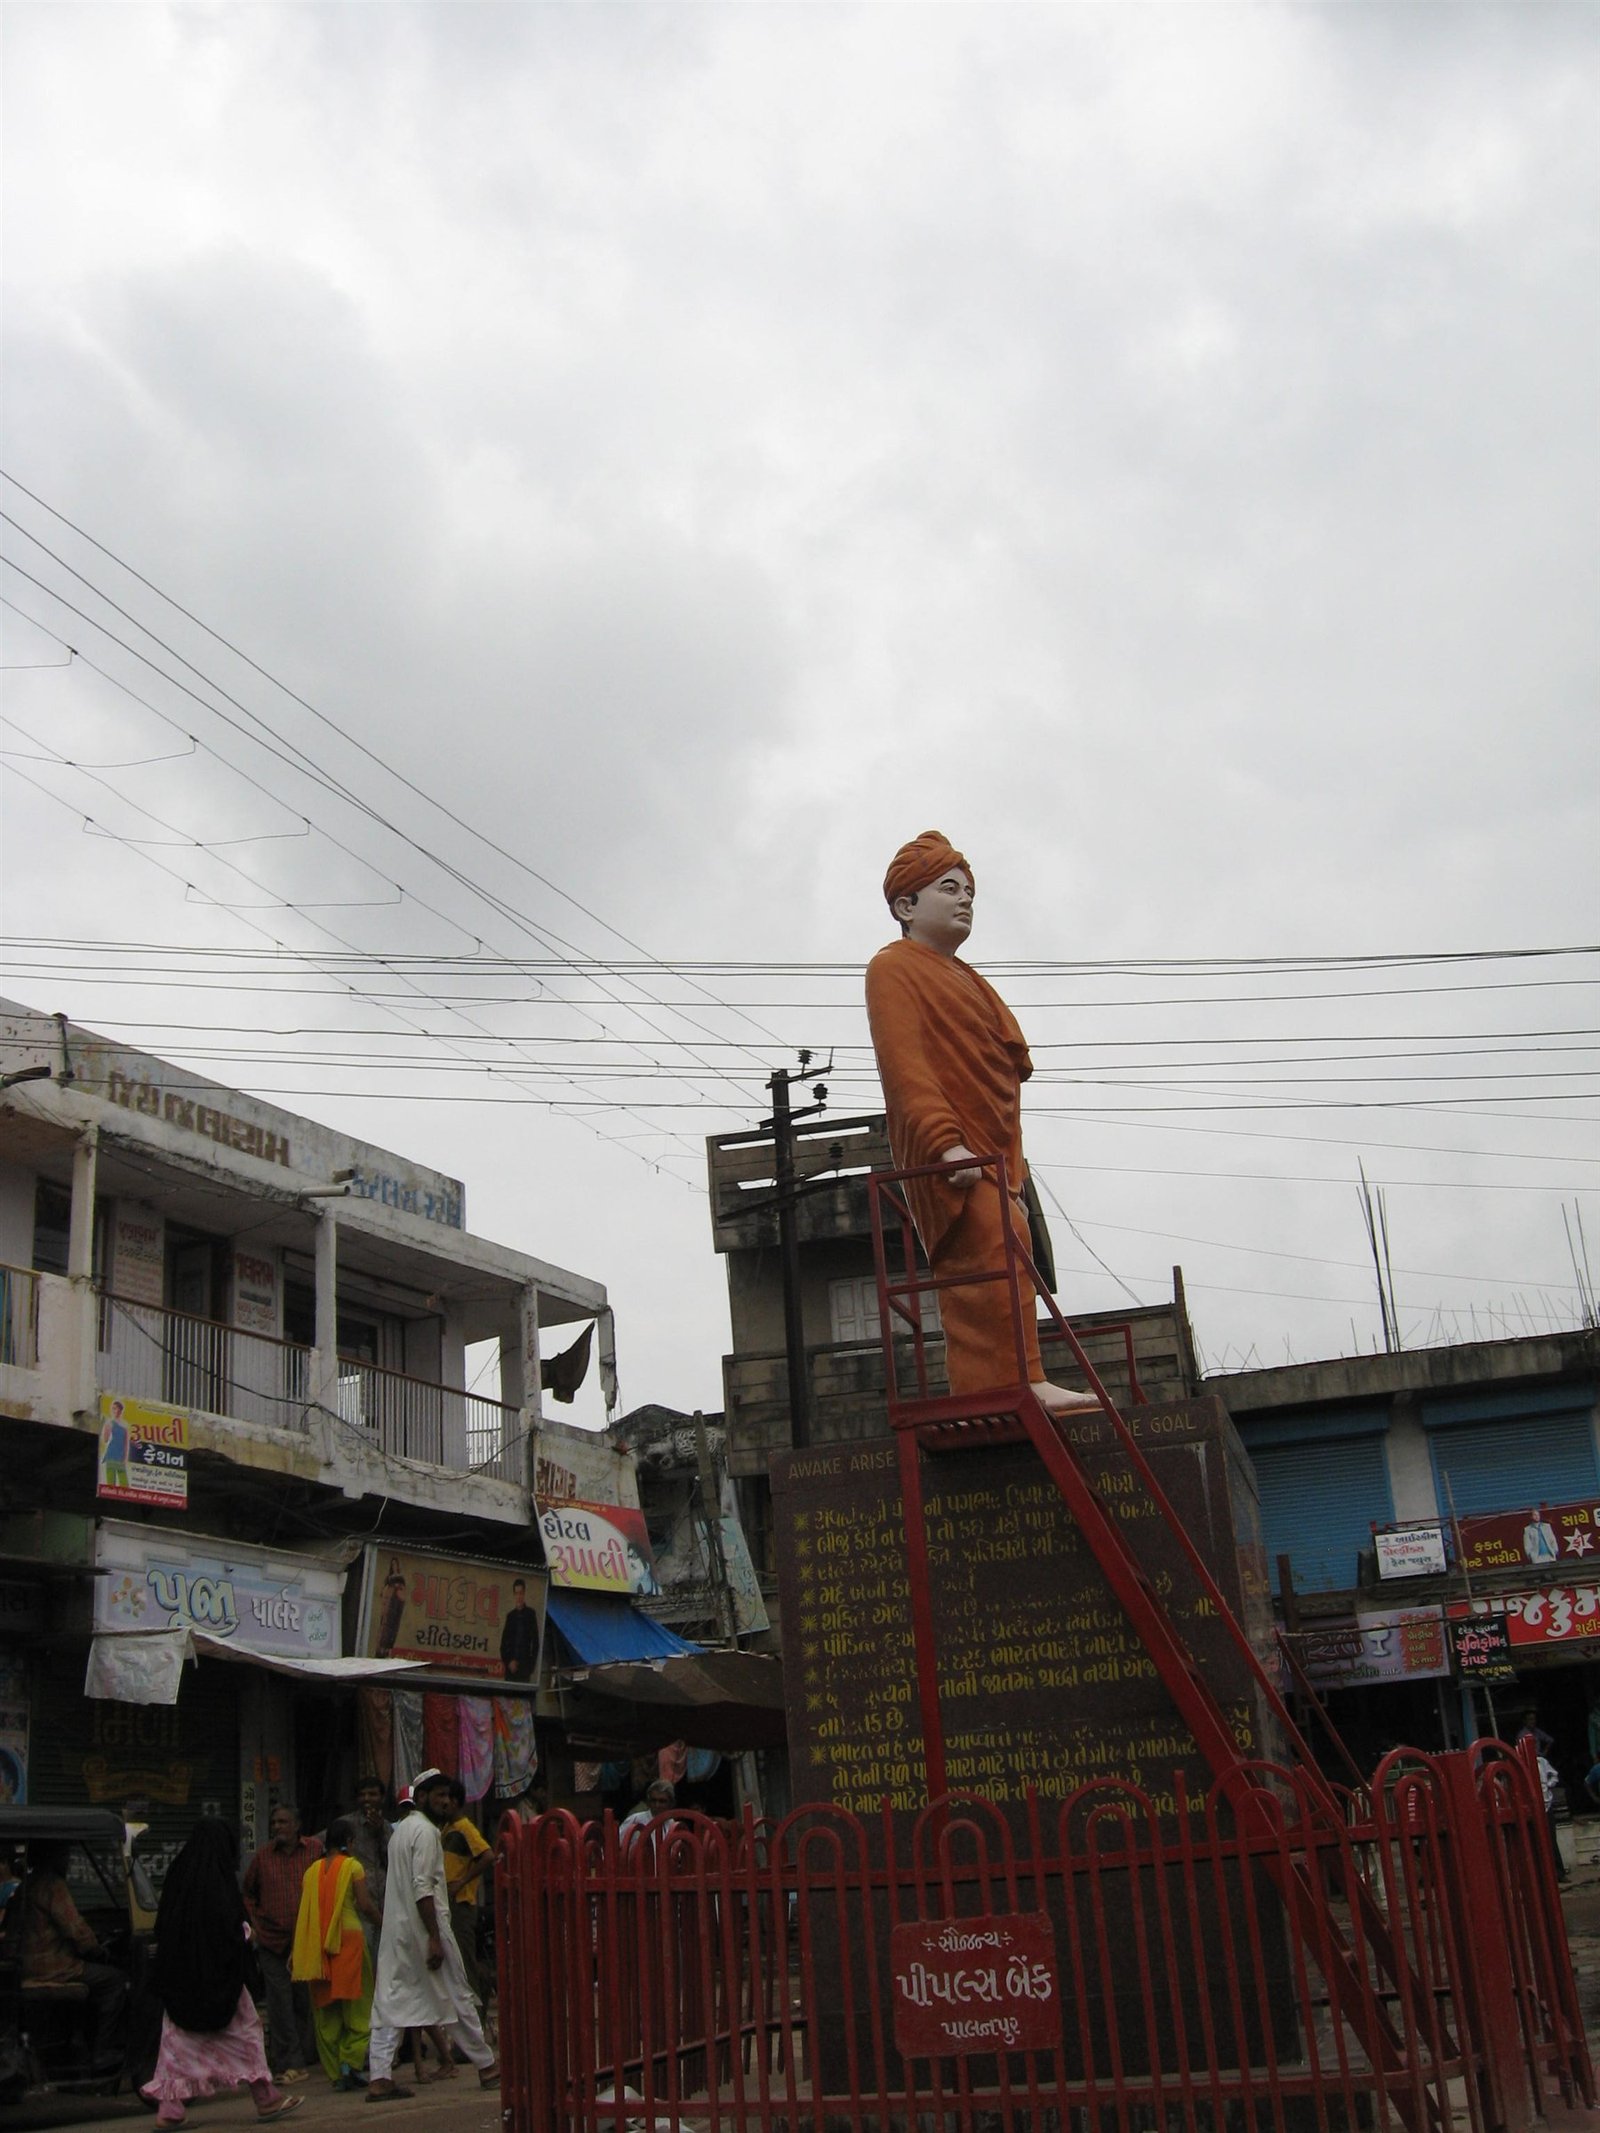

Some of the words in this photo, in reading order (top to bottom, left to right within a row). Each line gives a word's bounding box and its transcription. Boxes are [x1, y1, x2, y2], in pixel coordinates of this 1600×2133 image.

[143, 1444, 184, 1467] ફેશન
[788, 1457, 842, 1479] AWAKE
[850, 1450, 897, 1472] ARISE
[1070, 1424, 1100, 1443] ACH
[1150, 1413, 1197, 1434] GOAL
[544, 1507, 591, 1541] હોટલ
[1561, 1509, 1589, 1526] સાથે
[550, 1538, 628, 1585] રૂપાલી
[251, 1587, 301, 1632] પાર્લર
[411, 1572, 500, 1627] માધવ
[937, 1926, 1003, 1953] સૌજન્ય
[896, 1962, 1003, 2006] પીપલ્સ
[1006, 1955, 1052, 2002] બેંક
[940, 2016, 1021, 2045] પાલનપુર
